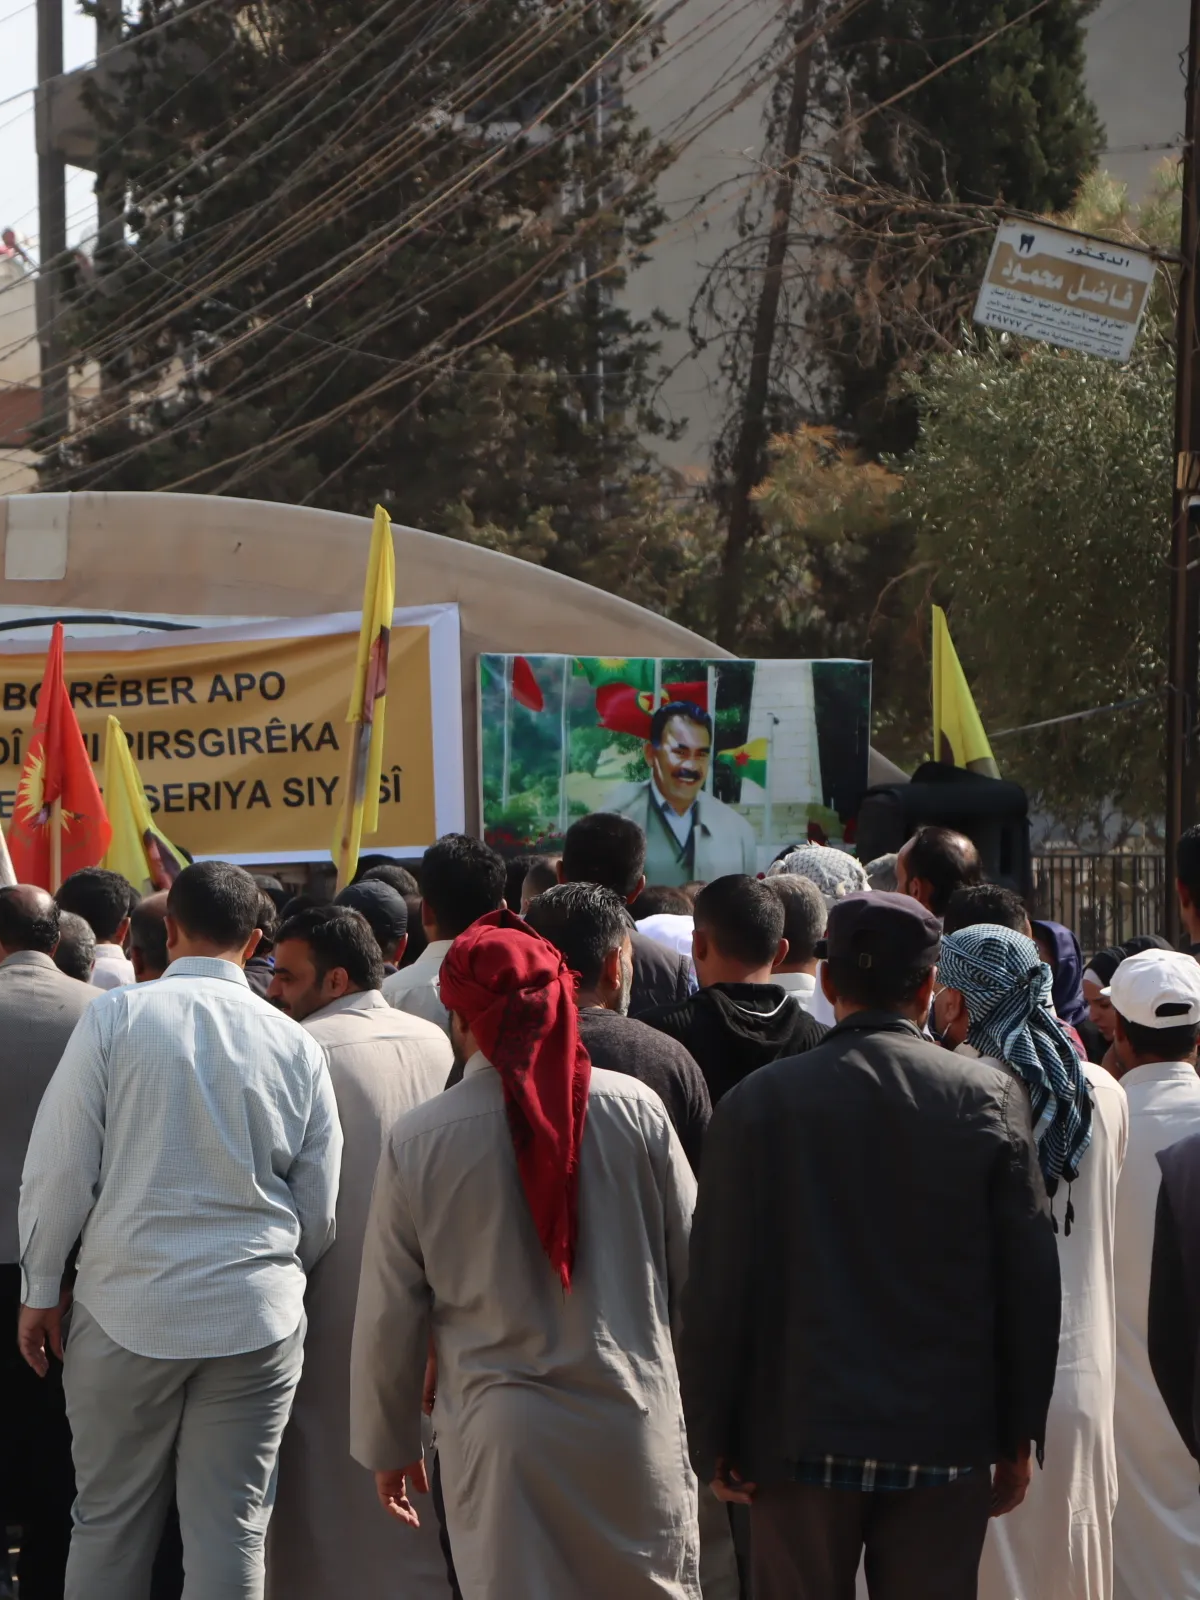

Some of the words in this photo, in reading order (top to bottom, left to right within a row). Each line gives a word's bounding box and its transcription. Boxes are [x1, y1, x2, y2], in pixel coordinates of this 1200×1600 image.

[1067, 245, 1130, 267] الدكتور
[1001, 258, 1064, 289] محمود
[1067, 274, 1133, 310] فاضل
[70, 673, 197, 709] RÊBER
[208, 671, 286, 703] APO
